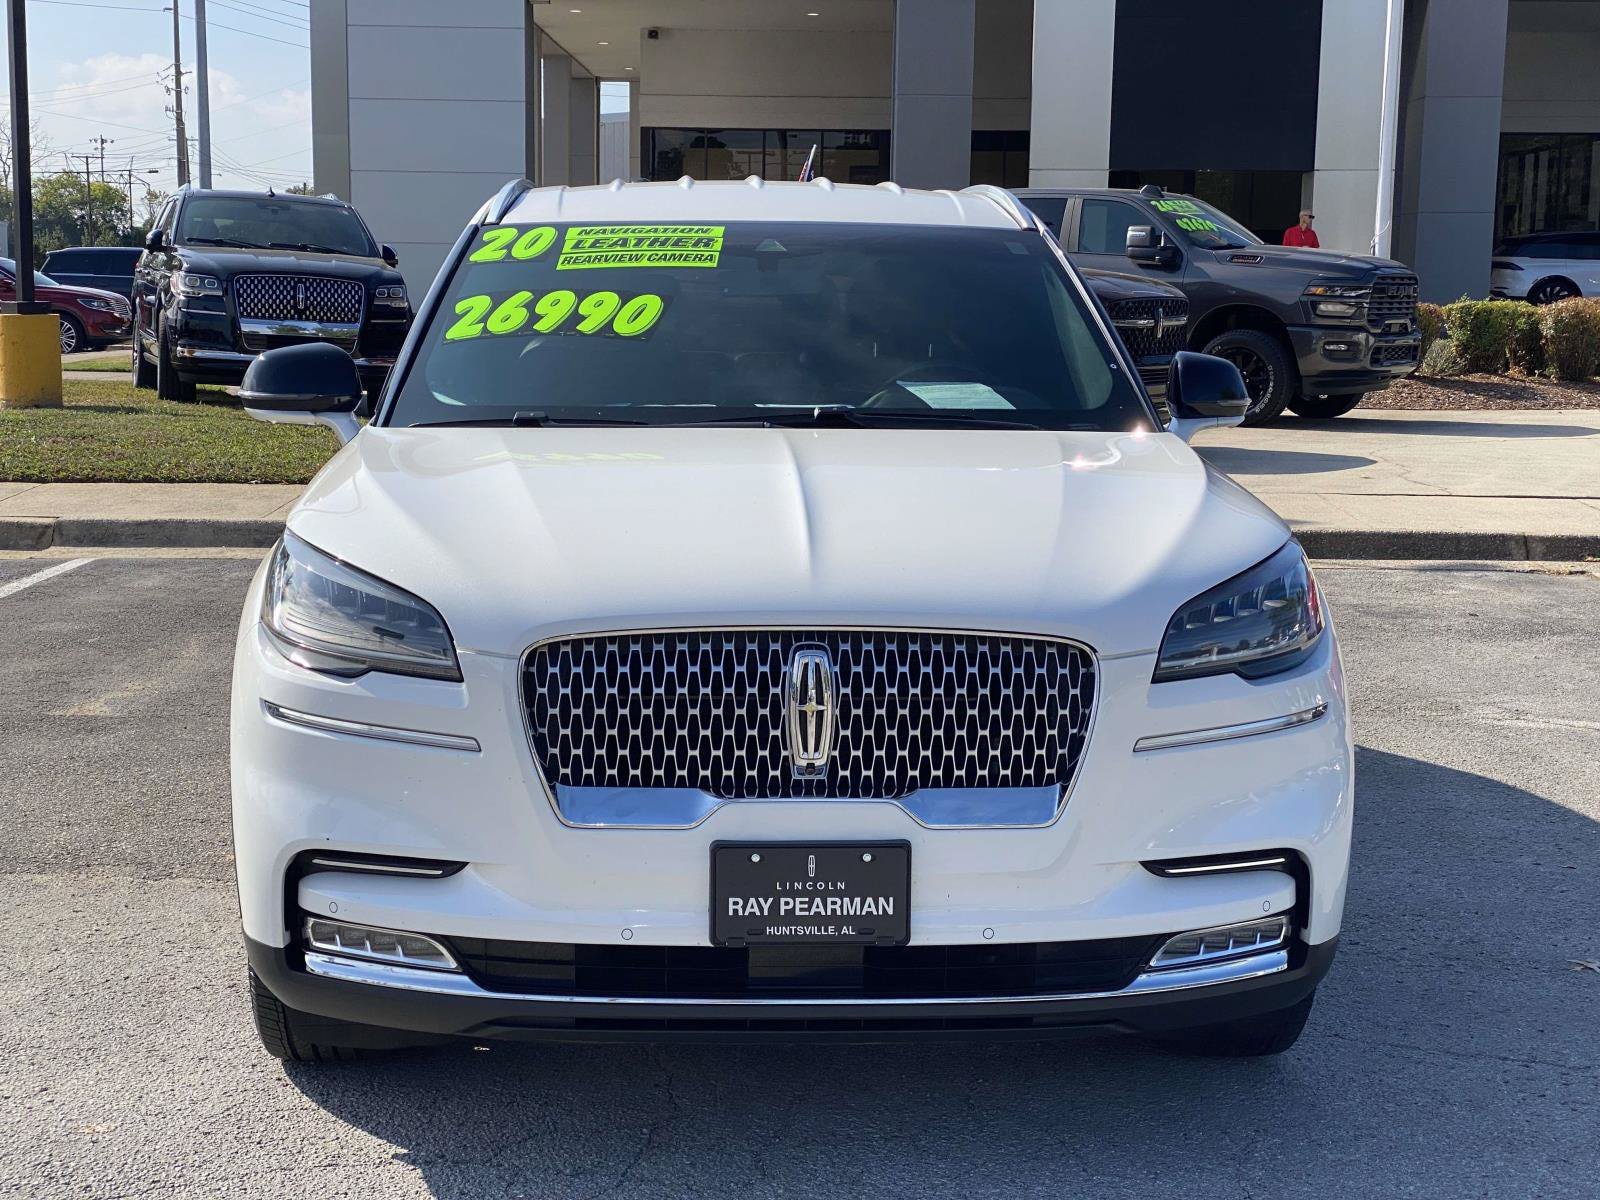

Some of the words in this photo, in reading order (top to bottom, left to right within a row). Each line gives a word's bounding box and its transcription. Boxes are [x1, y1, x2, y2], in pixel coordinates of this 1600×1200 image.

[576, 227, 712, 236] NAVIGATION
[469, 226, 558, 262] 20
[570, 237, 715, 249] LEATHER
[561, 253, 642, 266] REARVIEW
[646, 253, 715, 263] CAMERA
[445, 290, 664, 340] 26990
[776, 881, 845, 890] LINCOLN
[728, 897, 773, 916] RAY
[779, 896, 894, 916] PEARMAN
[766, 926, 838, 936] HUNTSVILLE,
[841, 926, 856, 935] AL
